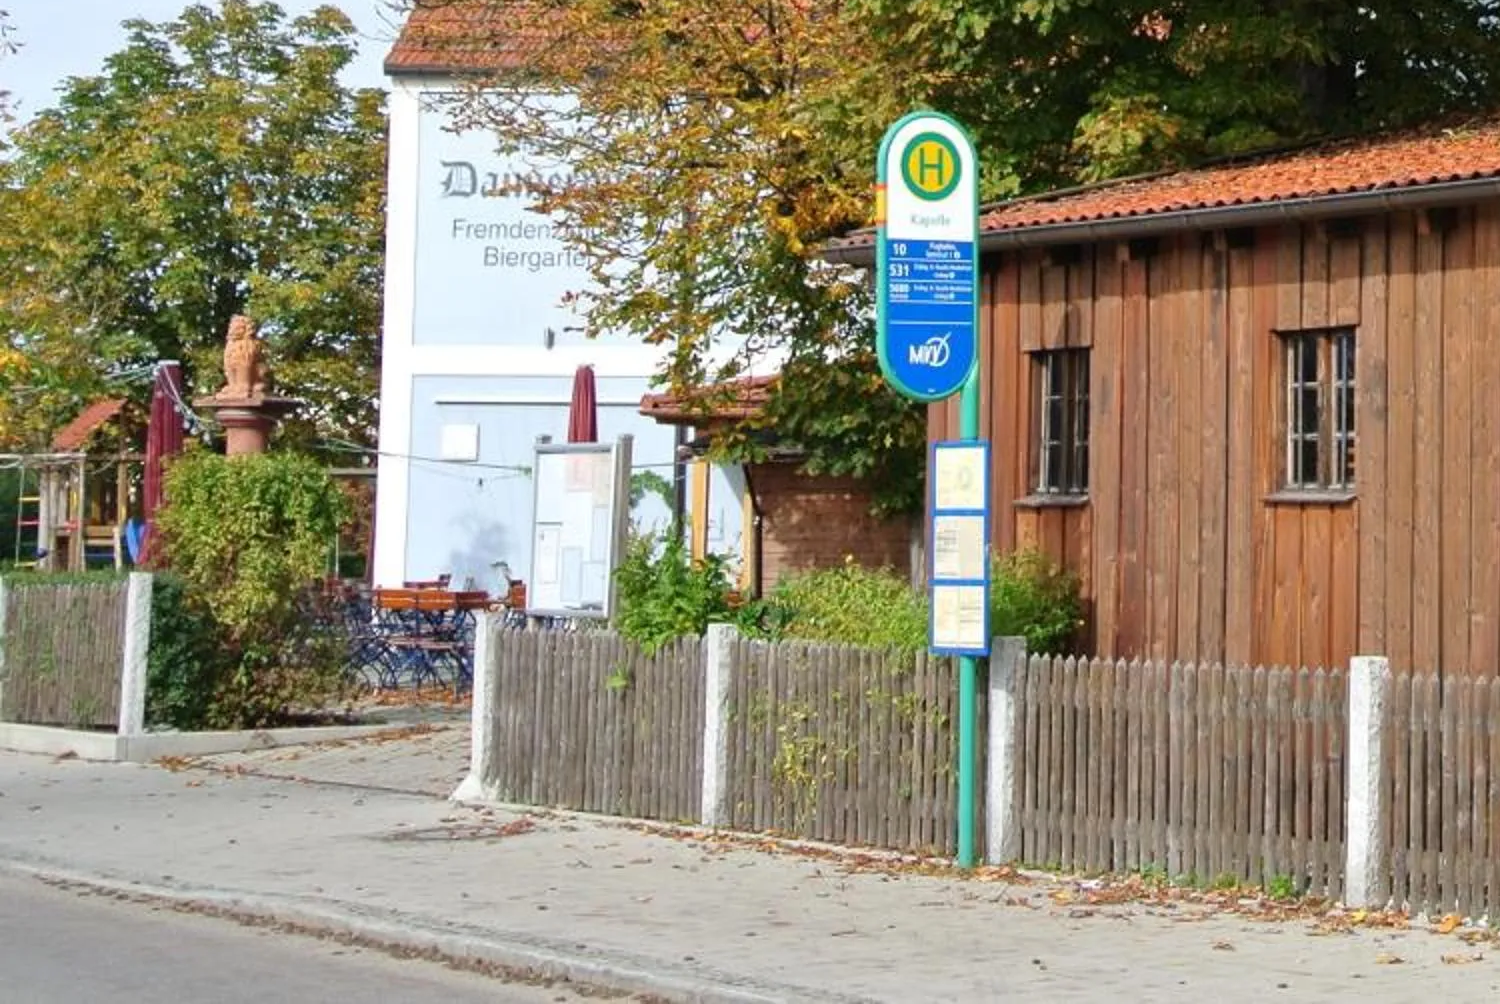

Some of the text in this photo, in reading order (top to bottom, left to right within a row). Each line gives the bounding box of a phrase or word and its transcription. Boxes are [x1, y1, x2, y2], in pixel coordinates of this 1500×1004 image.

[919, 147, 944, 186] H
[892, 243, 908, 256] 10
[889, 263, 910, 277] 531
